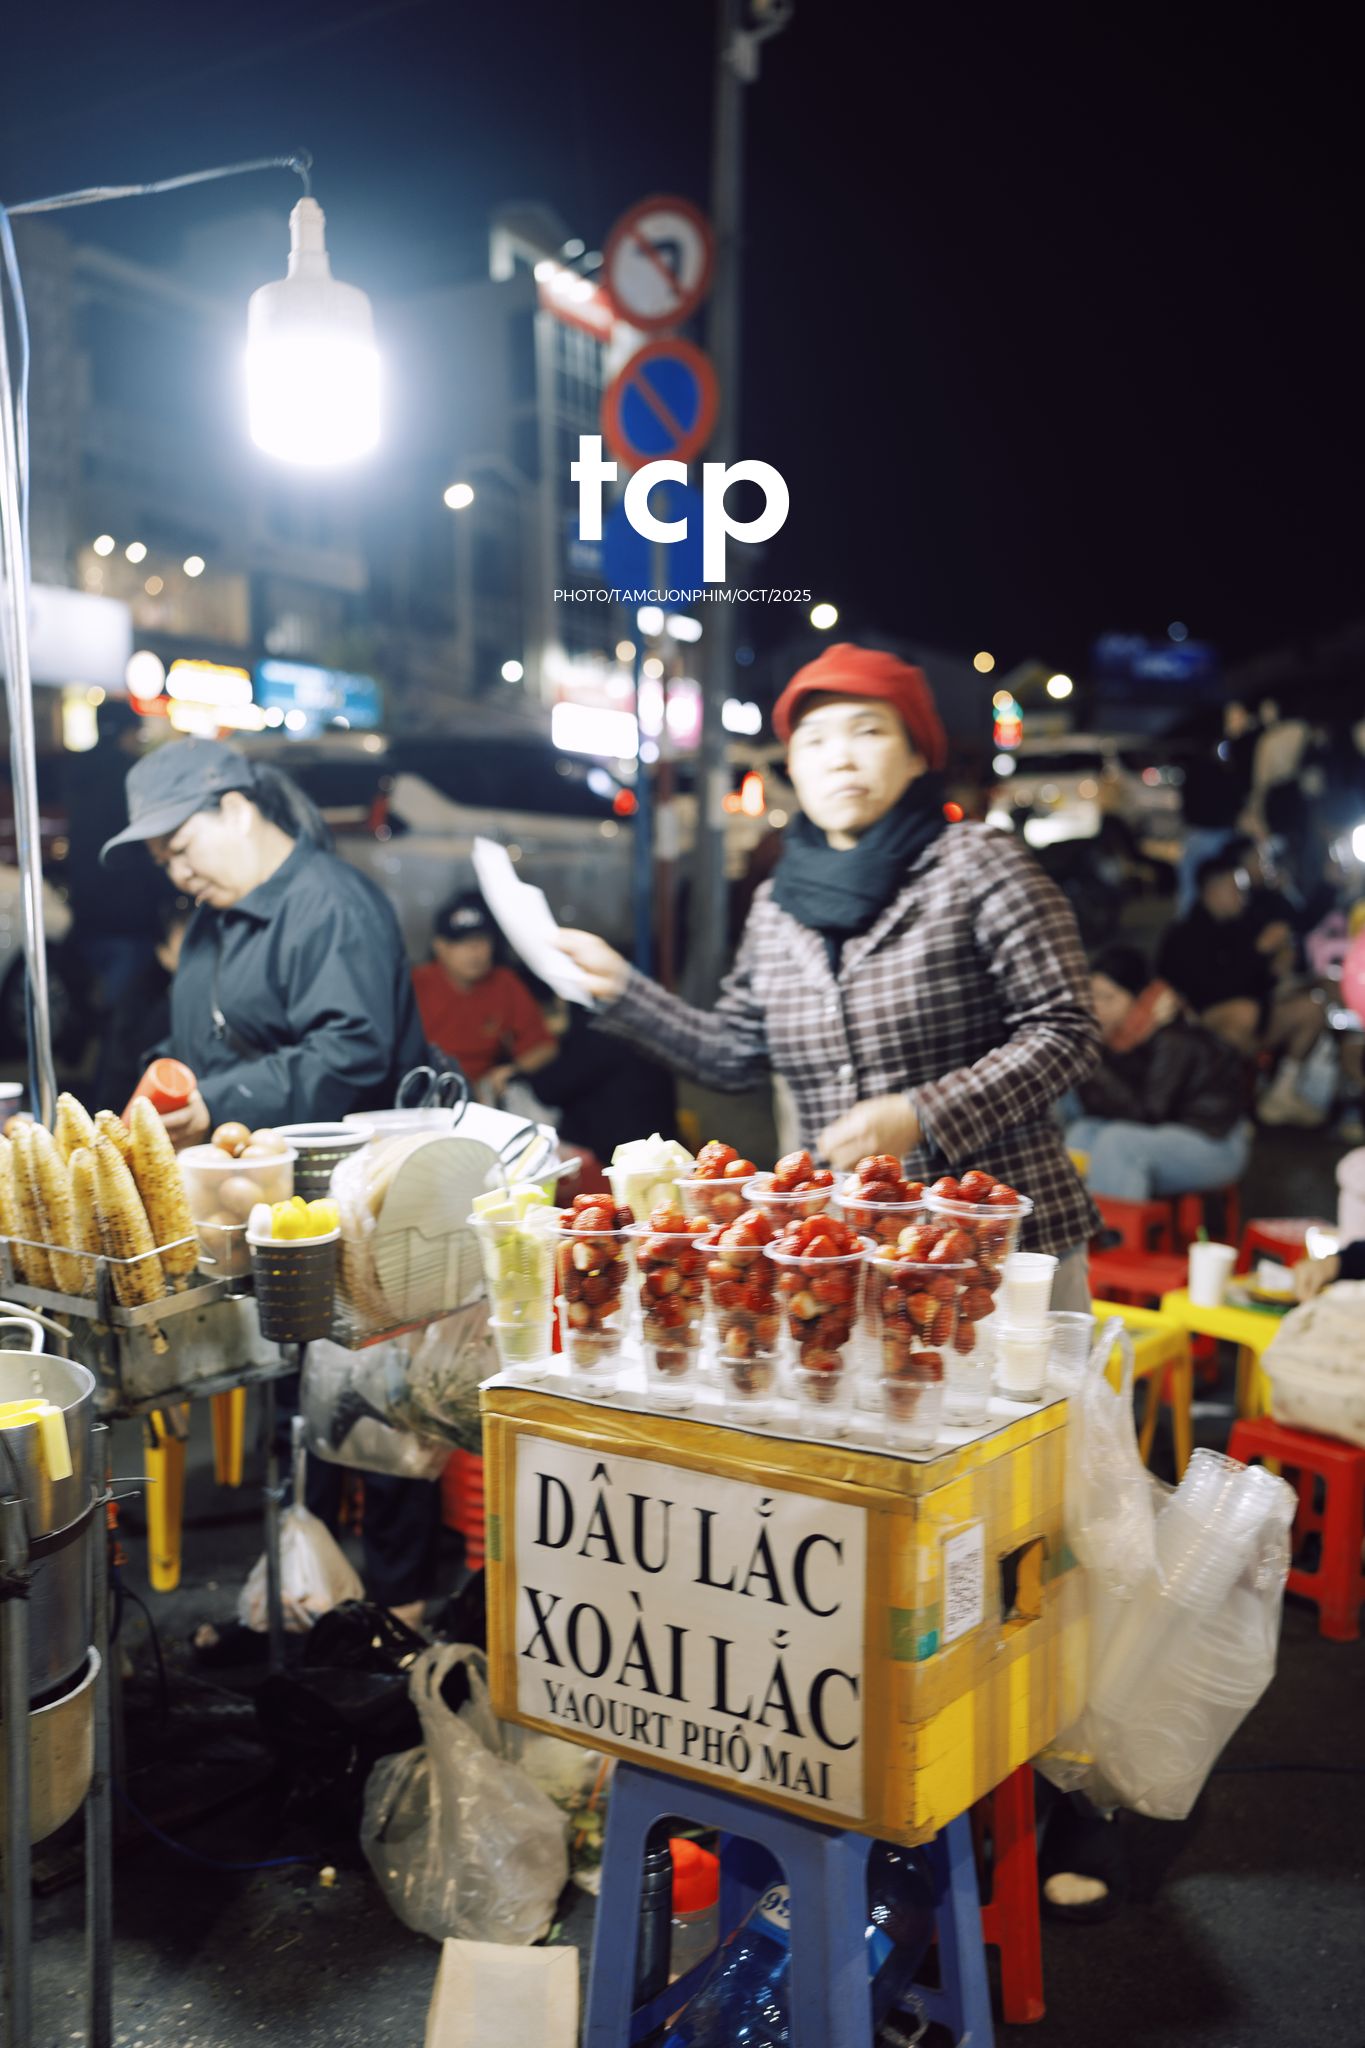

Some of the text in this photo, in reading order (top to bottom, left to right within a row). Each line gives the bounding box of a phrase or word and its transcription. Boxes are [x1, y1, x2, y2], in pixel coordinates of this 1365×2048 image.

[534, 1463, 844, 1617] DÂU LẮC
[521, 1586, 860, 1751] XOÀI LẮC
[543, 1680, 833, 1801] YAOURT PHÔ MAI
